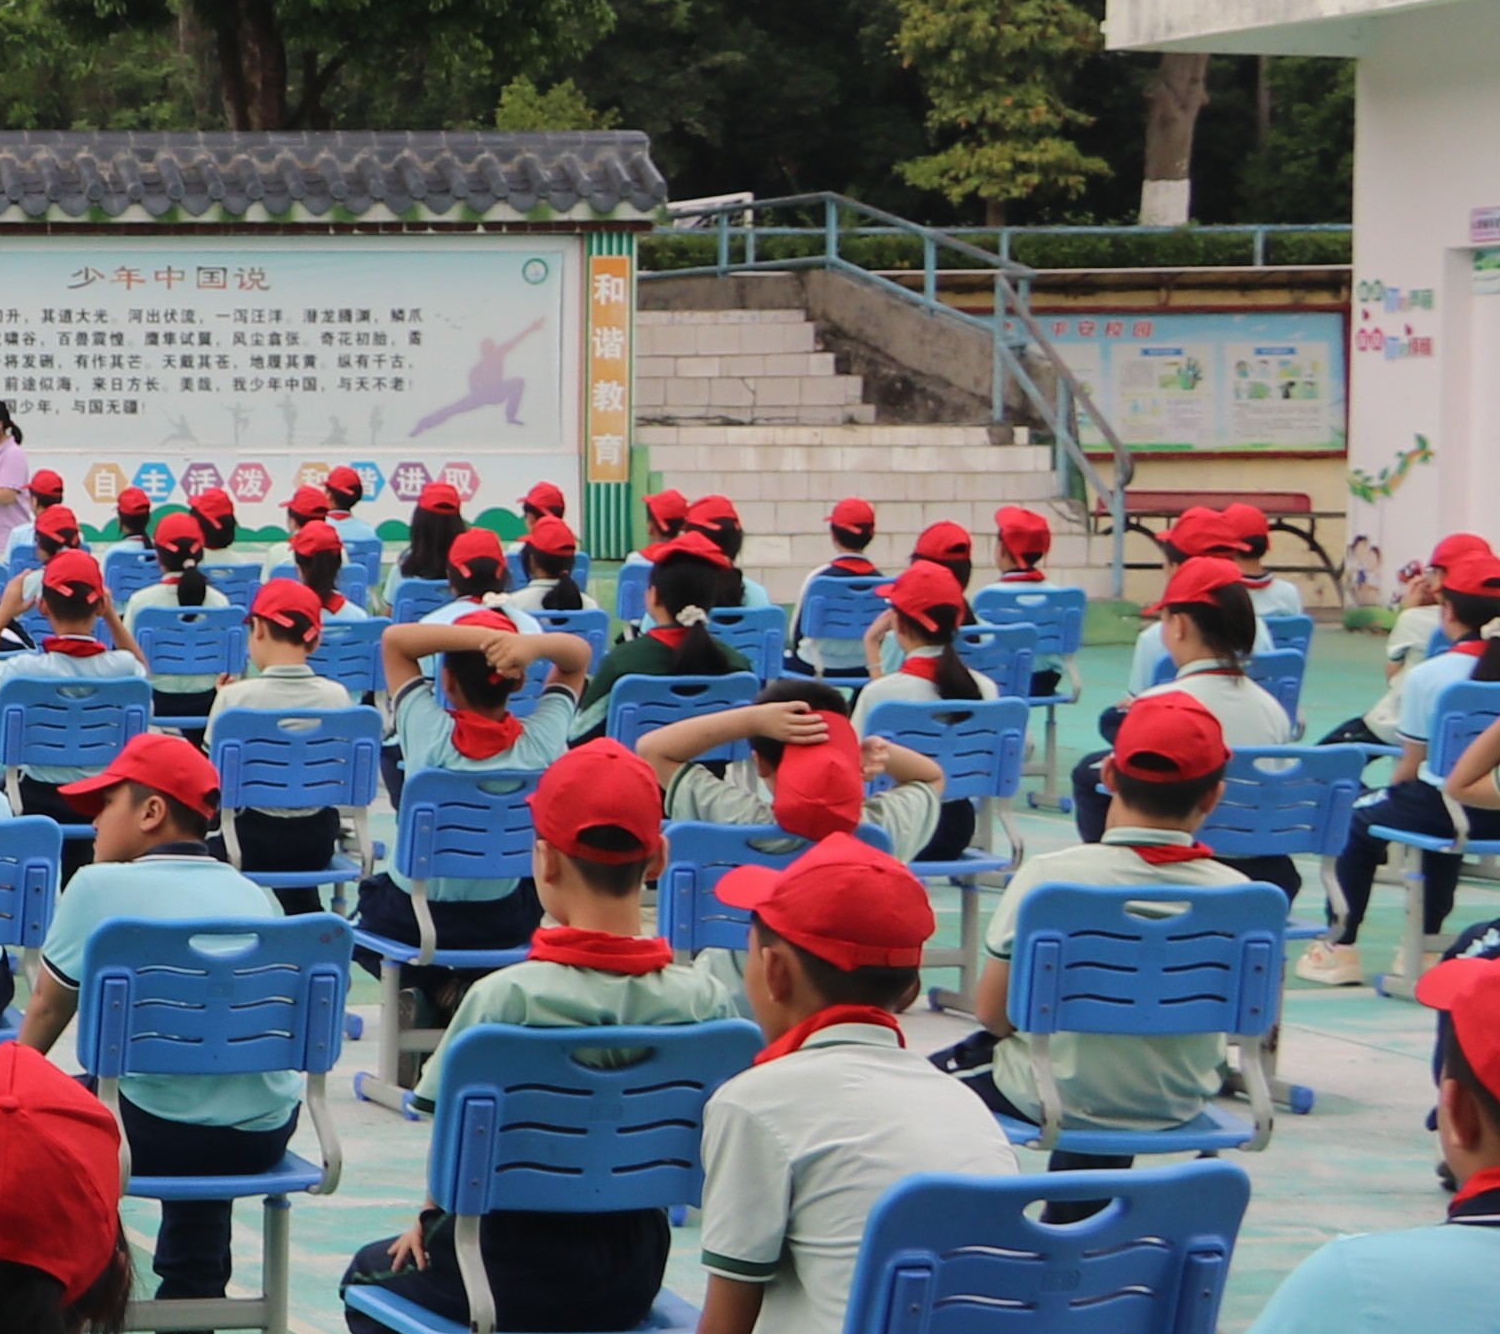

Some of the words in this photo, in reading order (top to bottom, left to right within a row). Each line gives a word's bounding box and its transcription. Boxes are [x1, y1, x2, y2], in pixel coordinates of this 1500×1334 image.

[67, 265, 271, 291] 少年中国说
[593, 273, 625, 465] 和谐教育
[95, 467, 265, 497] 自主活泼
